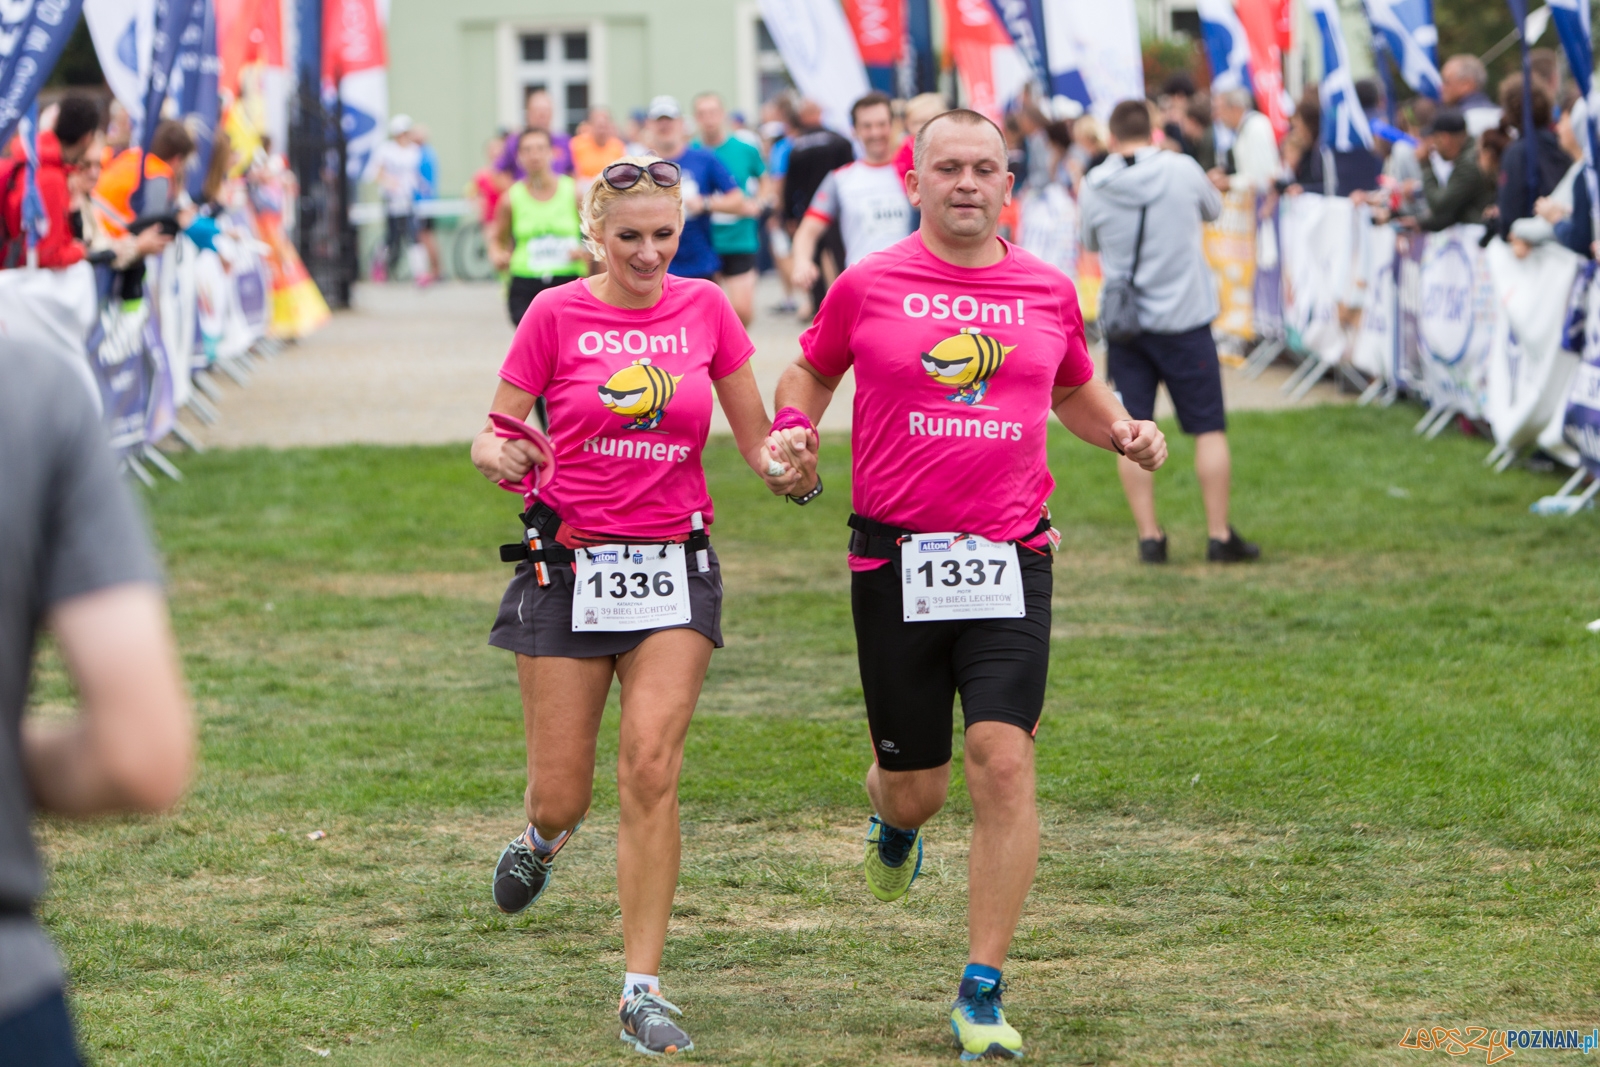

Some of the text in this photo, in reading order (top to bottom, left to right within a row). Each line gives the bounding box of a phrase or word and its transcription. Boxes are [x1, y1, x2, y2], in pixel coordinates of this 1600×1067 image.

[903, 293, 1025, 325] OSOm!
[578, 327, 689, 355] OSOm!
[909, 411, 1023, 441] Runners
[583, 436, 691, 463] Runners
[587, 571, 674, 598] 1336
[918, 559, 1007, 587] 1337
[600, 607, 611, 616] 39
[613, 607, 632, 615] BIEG
[932, 596, 944, 604] 39
[945, 595, 967, 603] BIEG
